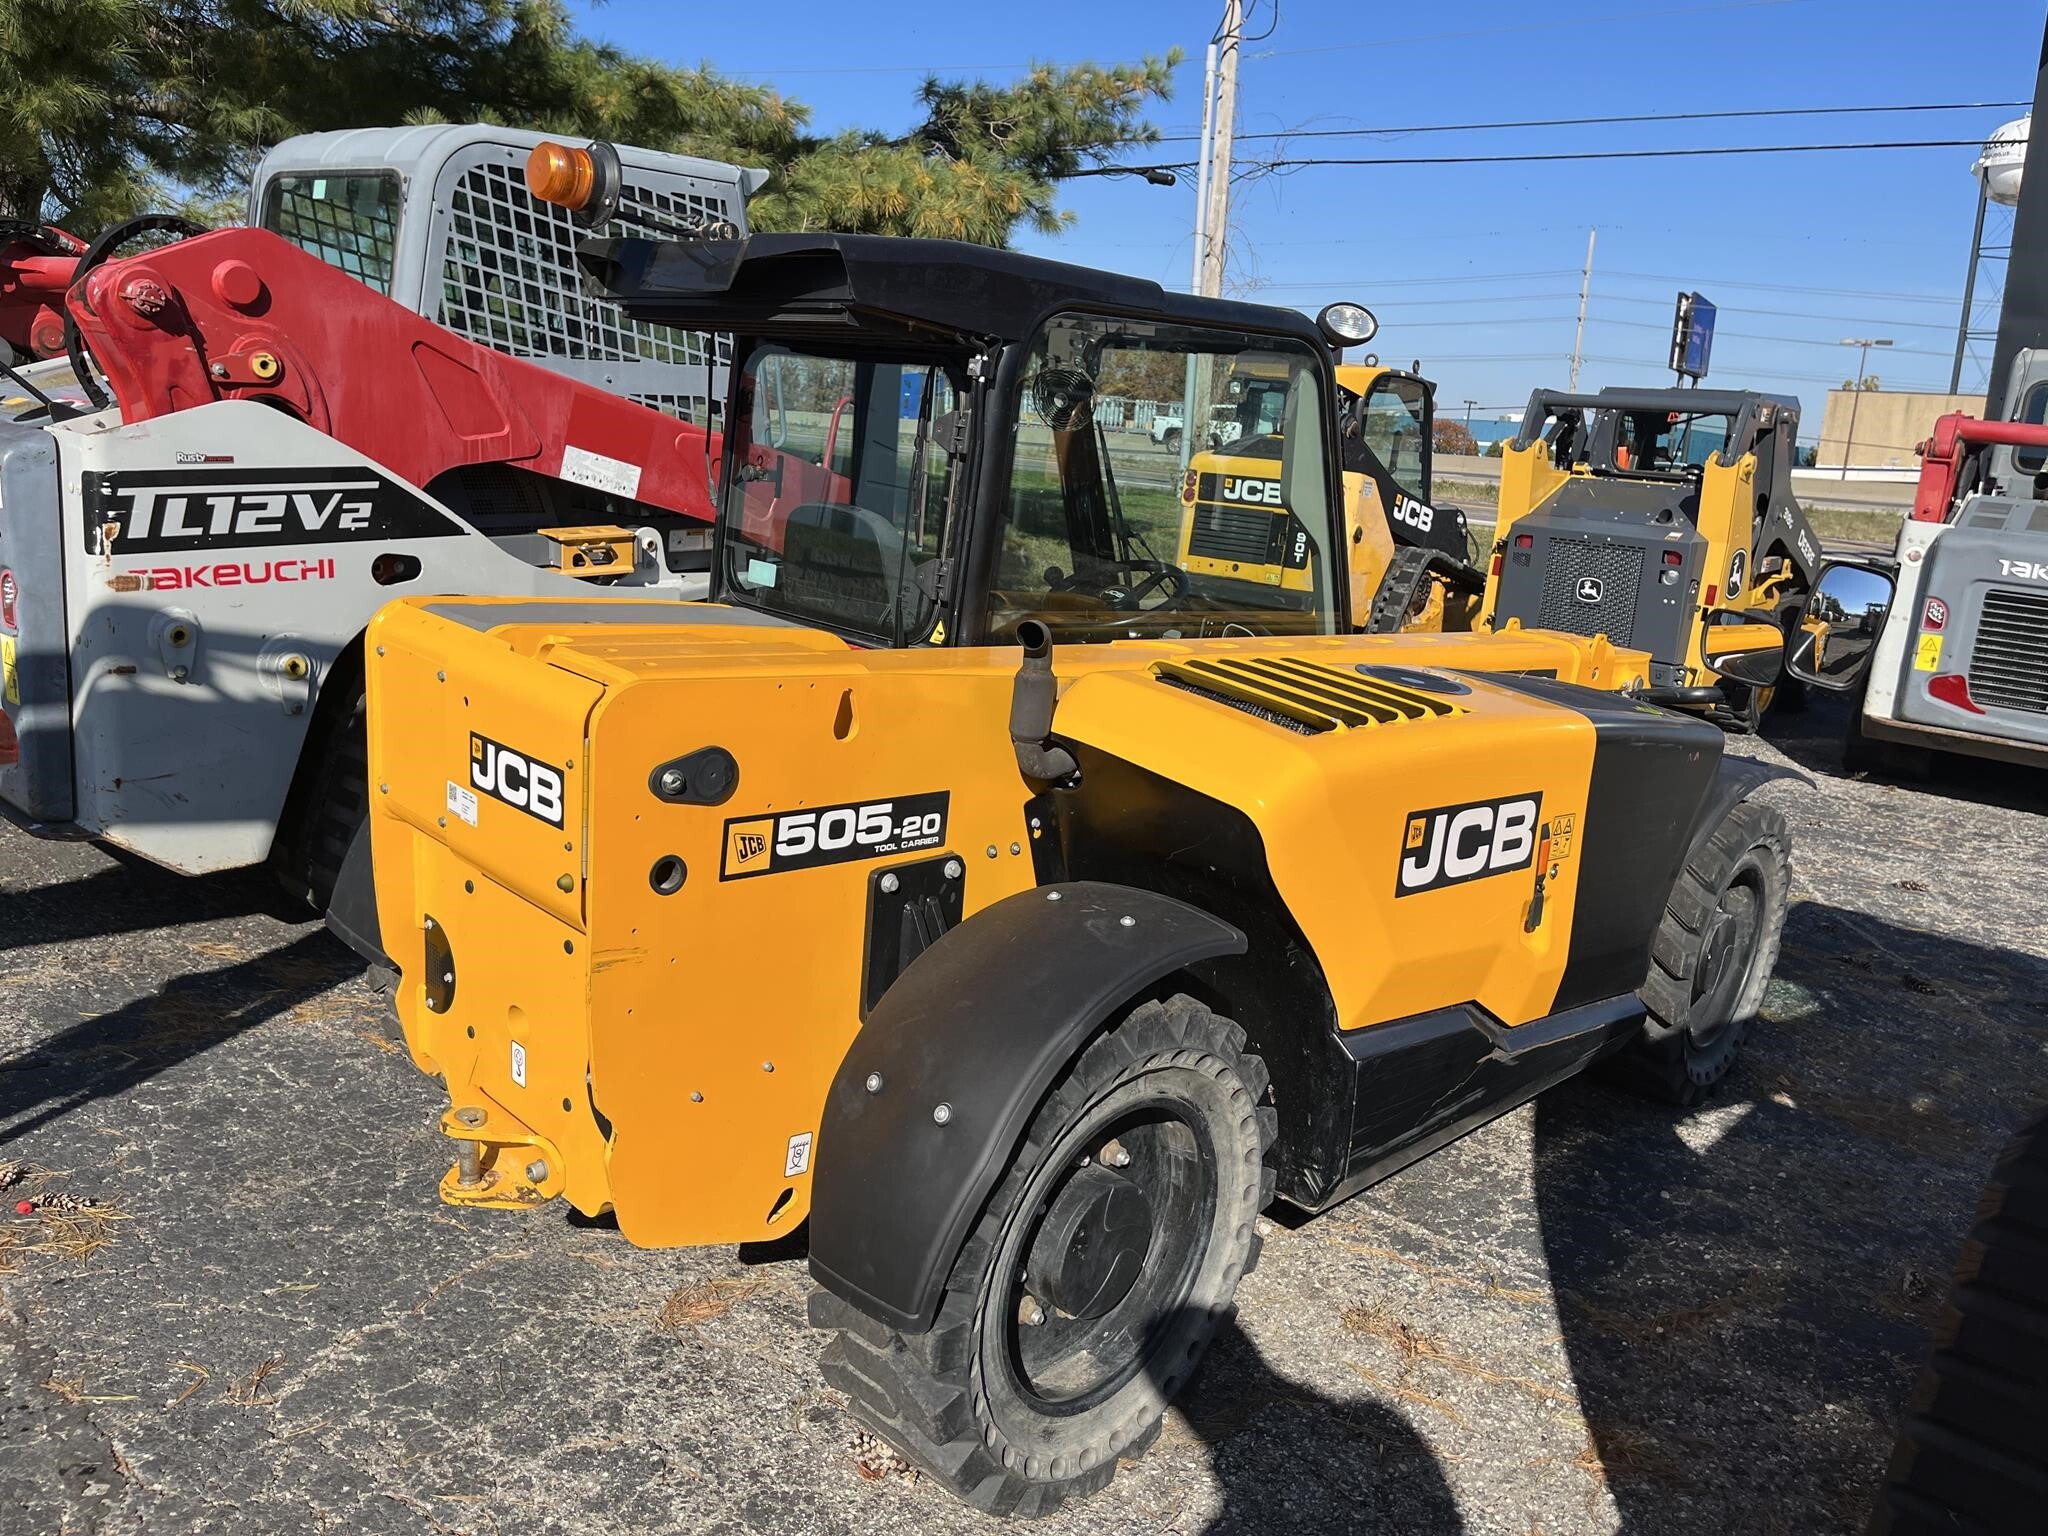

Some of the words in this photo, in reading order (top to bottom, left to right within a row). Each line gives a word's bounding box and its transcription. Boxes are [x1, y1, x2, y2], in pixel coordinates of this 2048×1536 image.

[177, 452, 206, 462] Rusty
[117, 481, 380, 539] TL12V2
[1393, 497, 1433, 532] JCB
[1293, 532, 1307, 562] 90T
[472, 743, 562, 822] JCB
[738, 834, 765, 859] JCB
[776, 803, 941, 856] 505-20
[874, 844, 897, 853] TOOL
[901, 836, 939, 849] CARRIER
[1402, 800, 1537, 887] JCB
